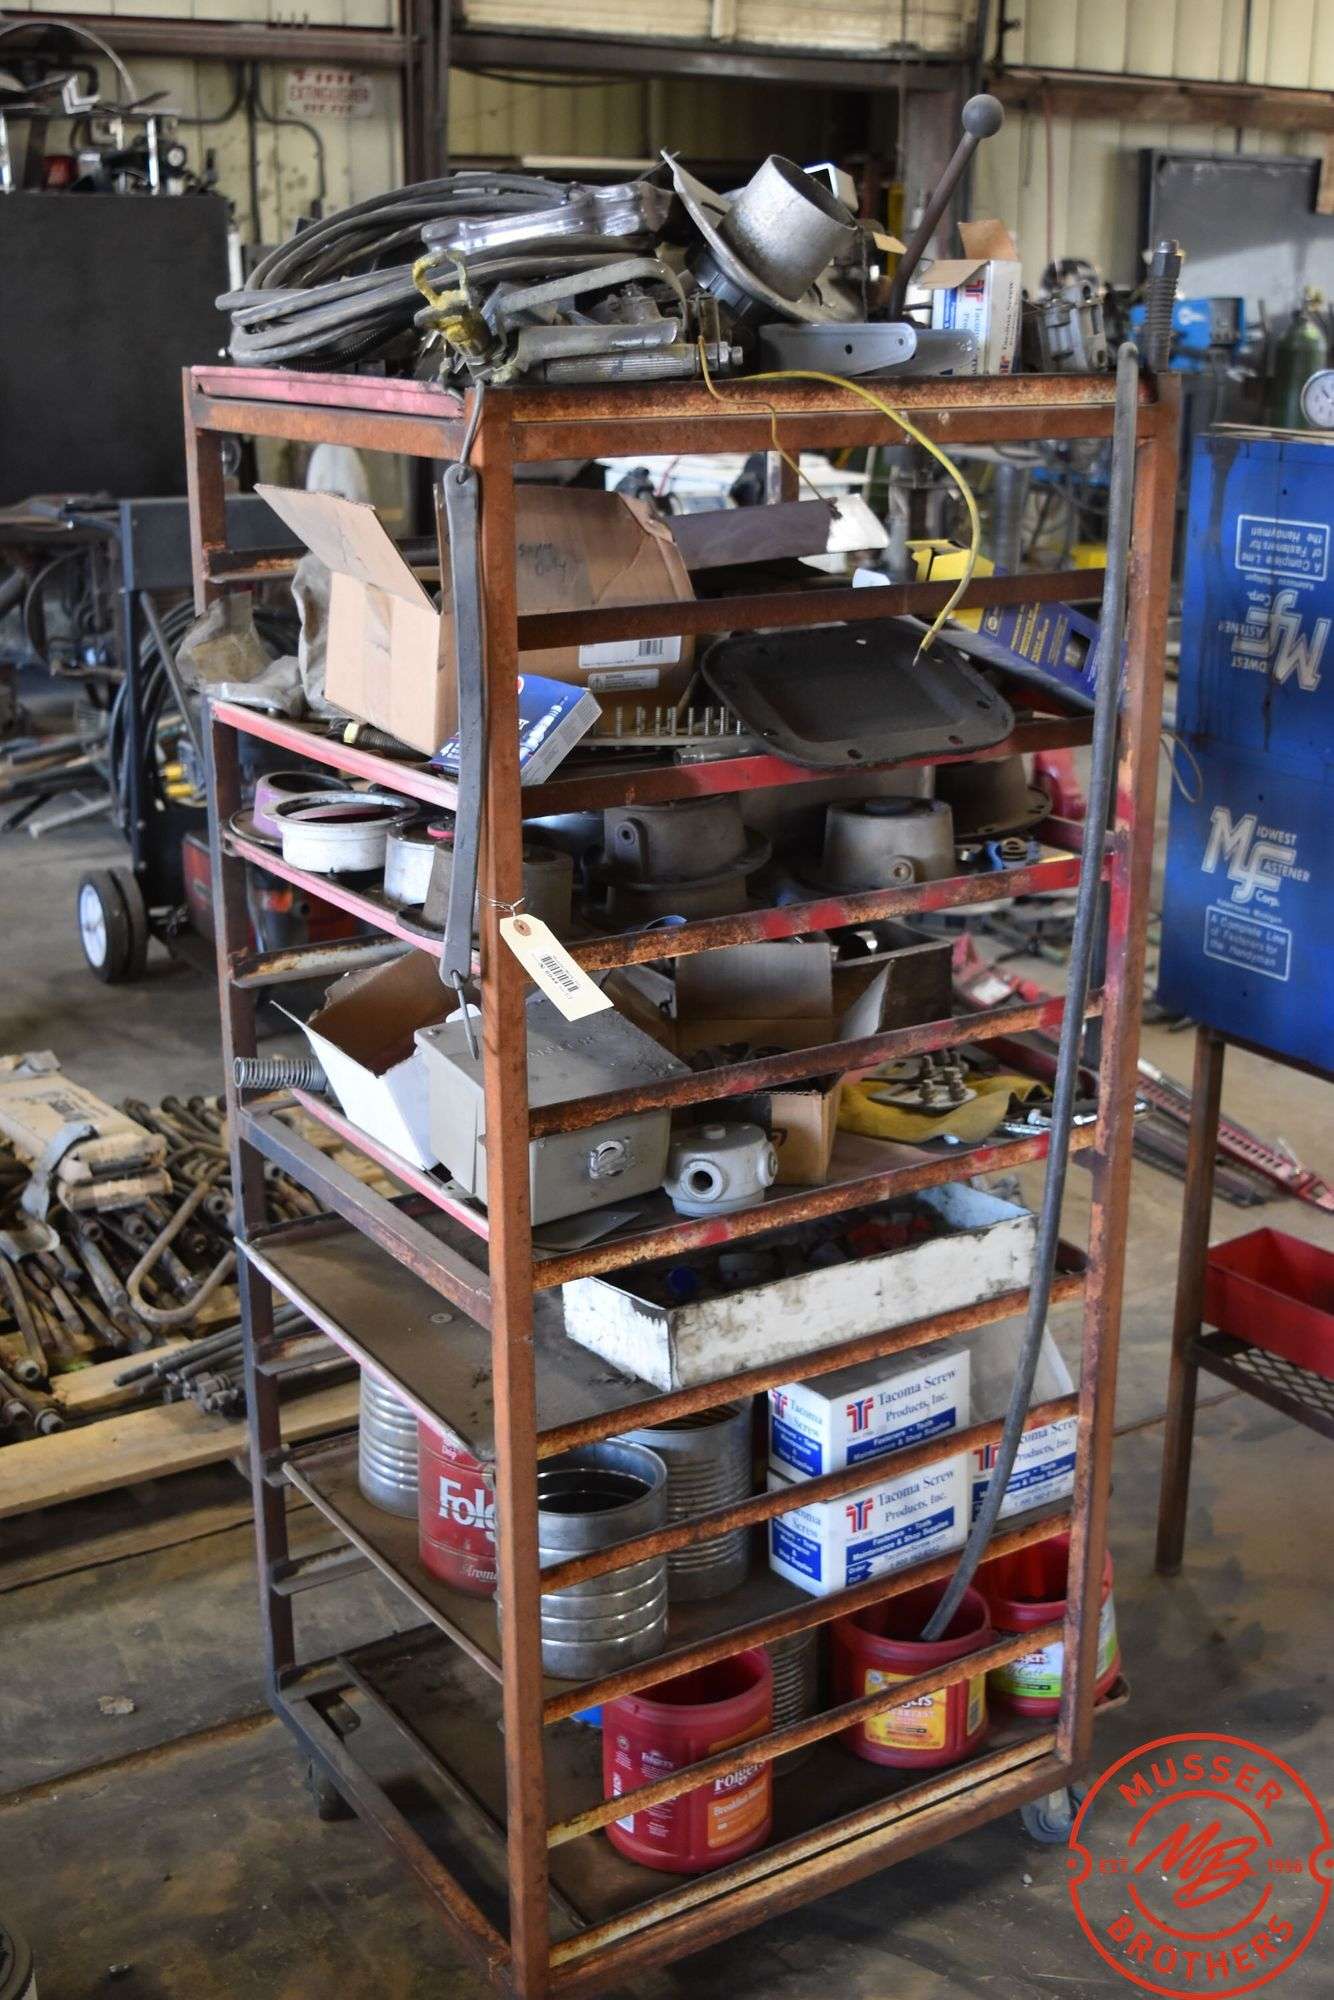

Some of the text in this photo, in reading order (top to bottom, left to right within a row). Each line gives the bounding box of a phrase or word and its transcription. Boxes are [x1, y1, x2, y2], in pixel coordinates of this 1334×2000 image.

[877, 1370, 957, 1406] Tacoma Screw
[886, 1393, 948, 1422] Products, Inc.
[877, 1470, 954, 1506] Tacoma Screw
[885, 1493, 946, 1522] Products, Inc.
